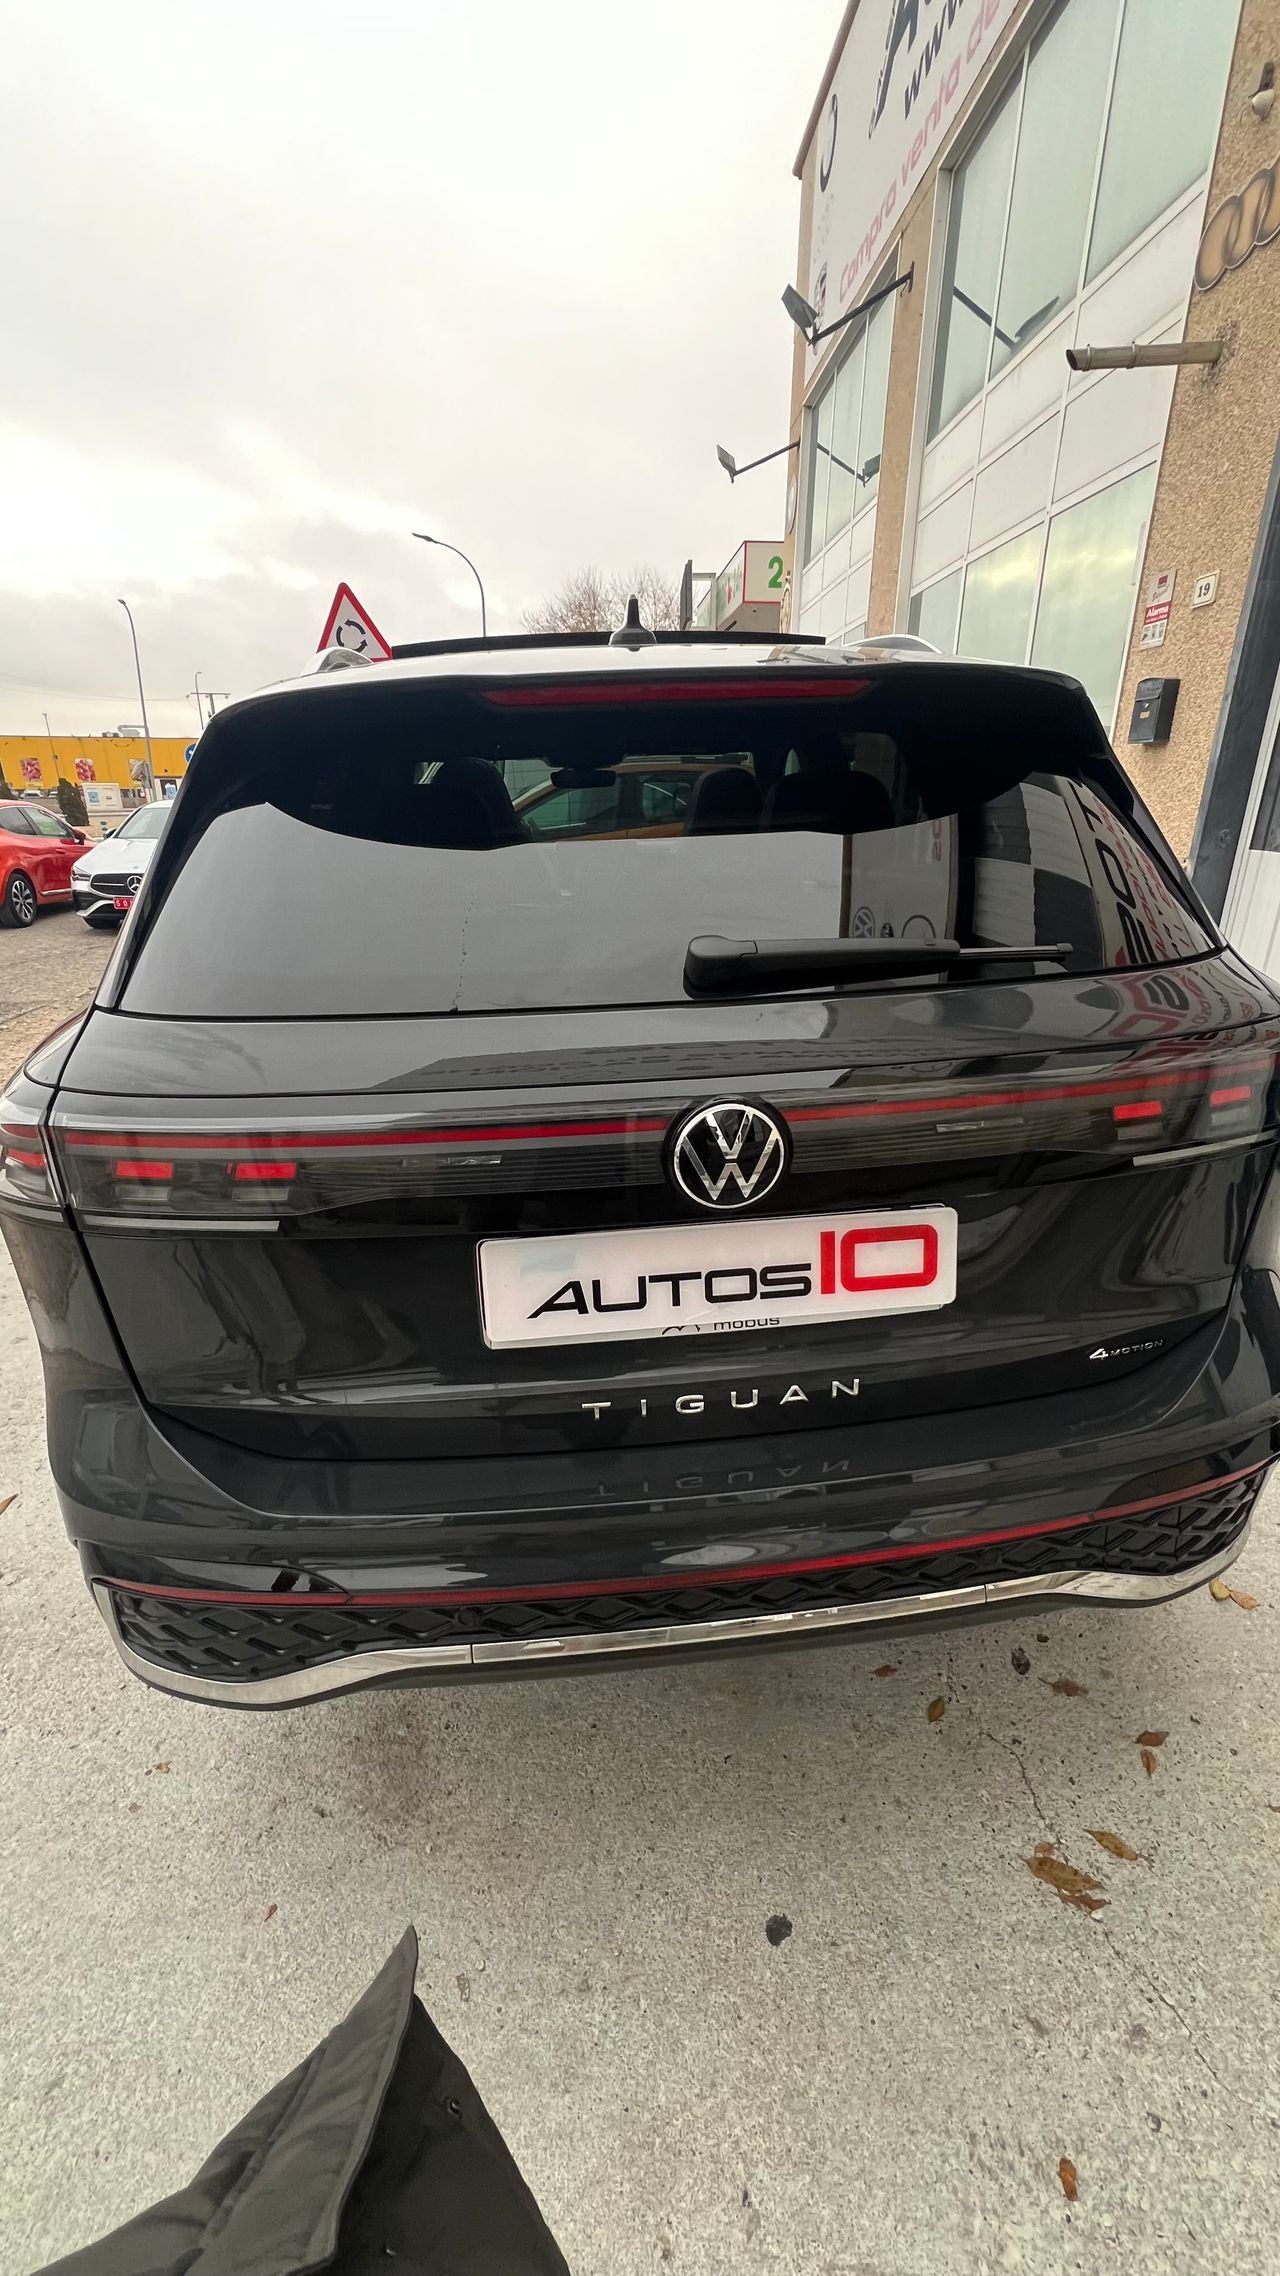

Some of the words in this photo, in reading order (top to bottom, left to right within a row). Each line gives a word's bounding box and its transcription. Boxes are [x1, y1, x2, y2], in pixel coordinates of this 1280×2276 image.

[901, 53, 961, 187] venta
[1197, 582, 1211, 598] 19
[582, 1378, 860, 1420] TIGUAN
